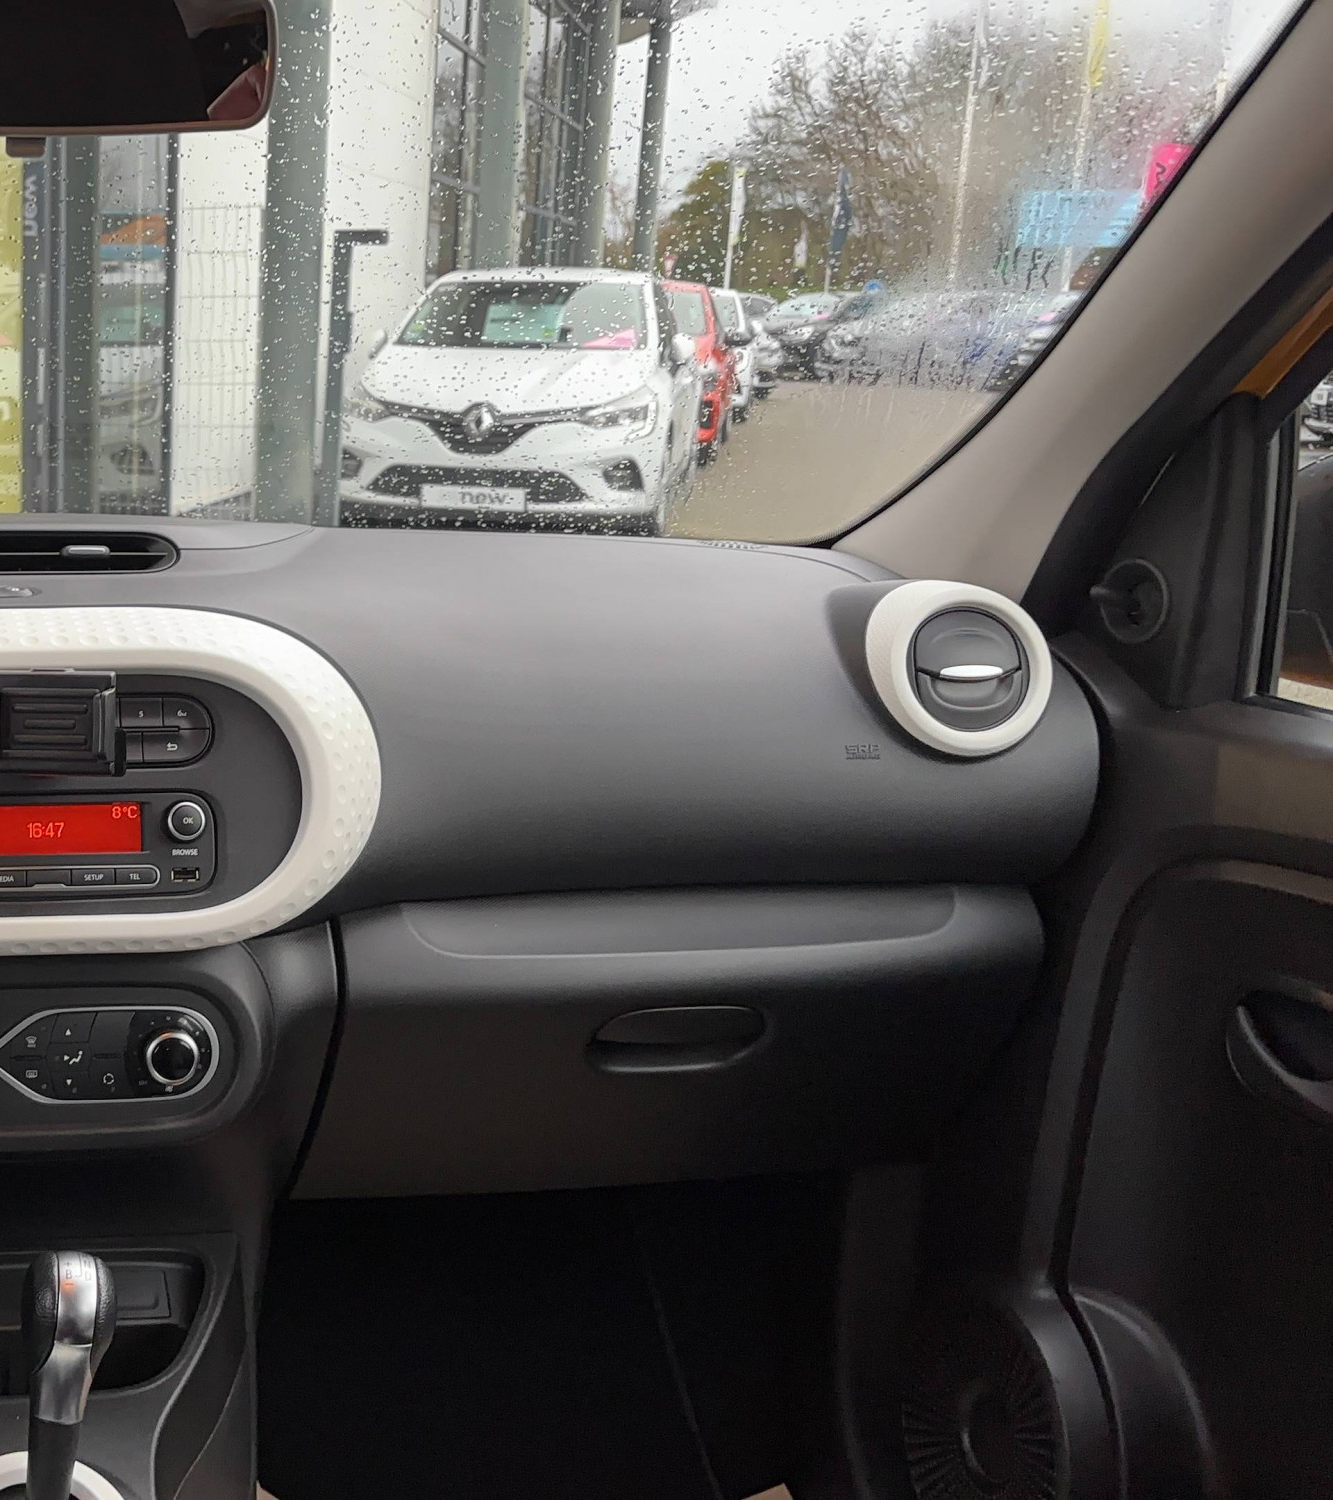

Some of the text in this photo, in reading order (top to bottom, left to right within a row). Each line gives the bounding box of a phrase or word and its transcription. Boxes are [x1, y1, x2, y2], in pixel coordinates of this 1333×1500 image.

[460, 491, 508, 505] new
[111, 804, 138, 819] 8°C
[182, 816, 194, 825] OK
[27, 821, 65, 838] 16:47
[171, 848, 199, 856] BROWSE
[83, 873, 104, 881] SETUP
[129, 873, 141, 881] TEL
[66, 1269, 72, 1280] B
